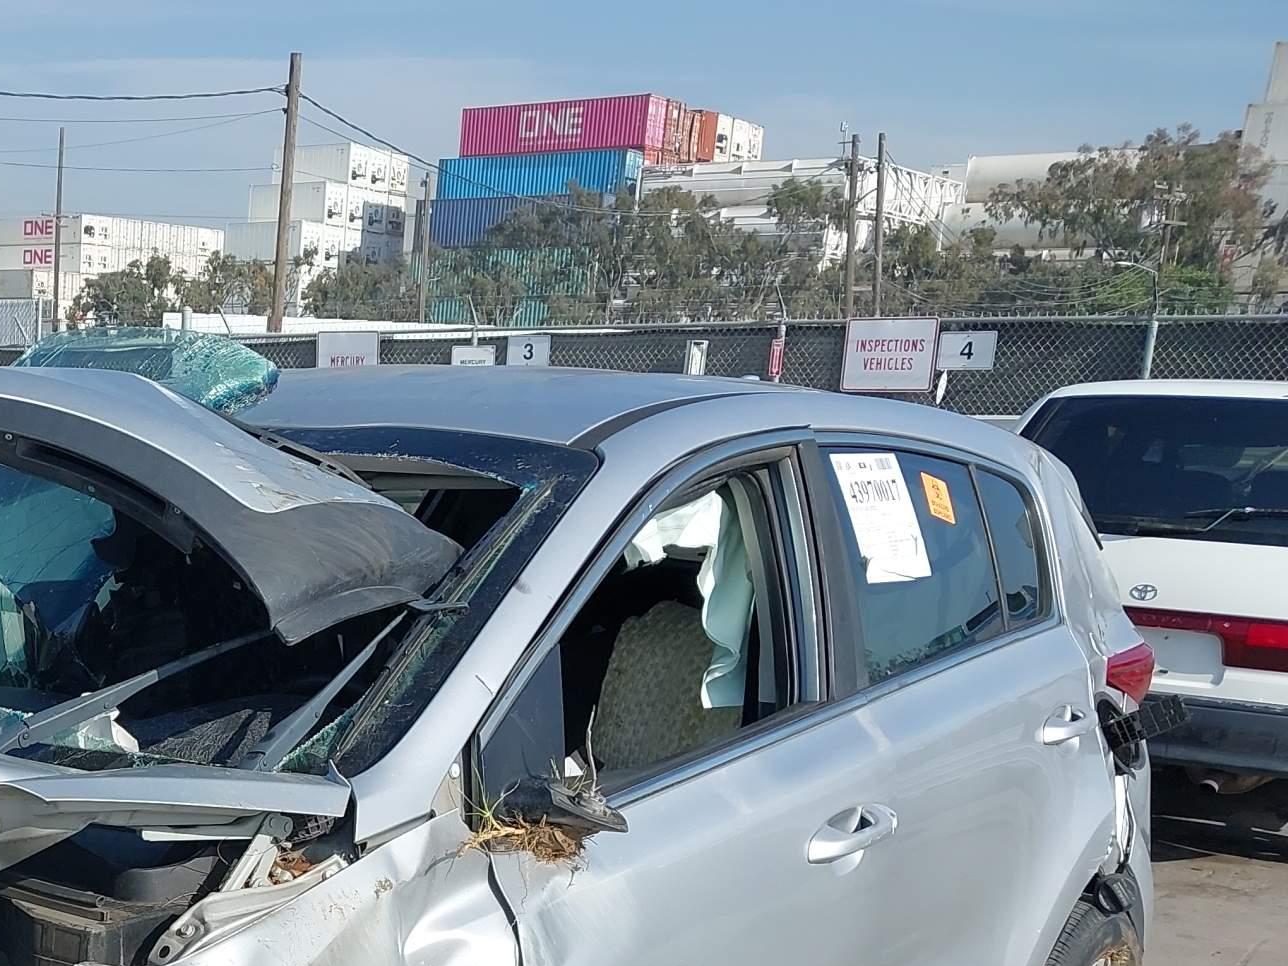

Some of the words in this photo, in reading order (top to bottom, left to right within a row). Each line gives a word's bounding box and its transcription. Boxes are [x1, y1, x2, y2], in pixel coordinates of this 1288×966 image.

[518, 107, 583, 138] ONE
[24, 220, 54, 236] ONE
[23, 249, 53, 265] ONE
[523, 343, 534, 360] 3
[856, 339, 926, 353] INSPECTIONS
[959, 341, 974, 360] 4
[863, 357, 914, 371] VEHICLES
[850, 479, 901, 504] 43970017
